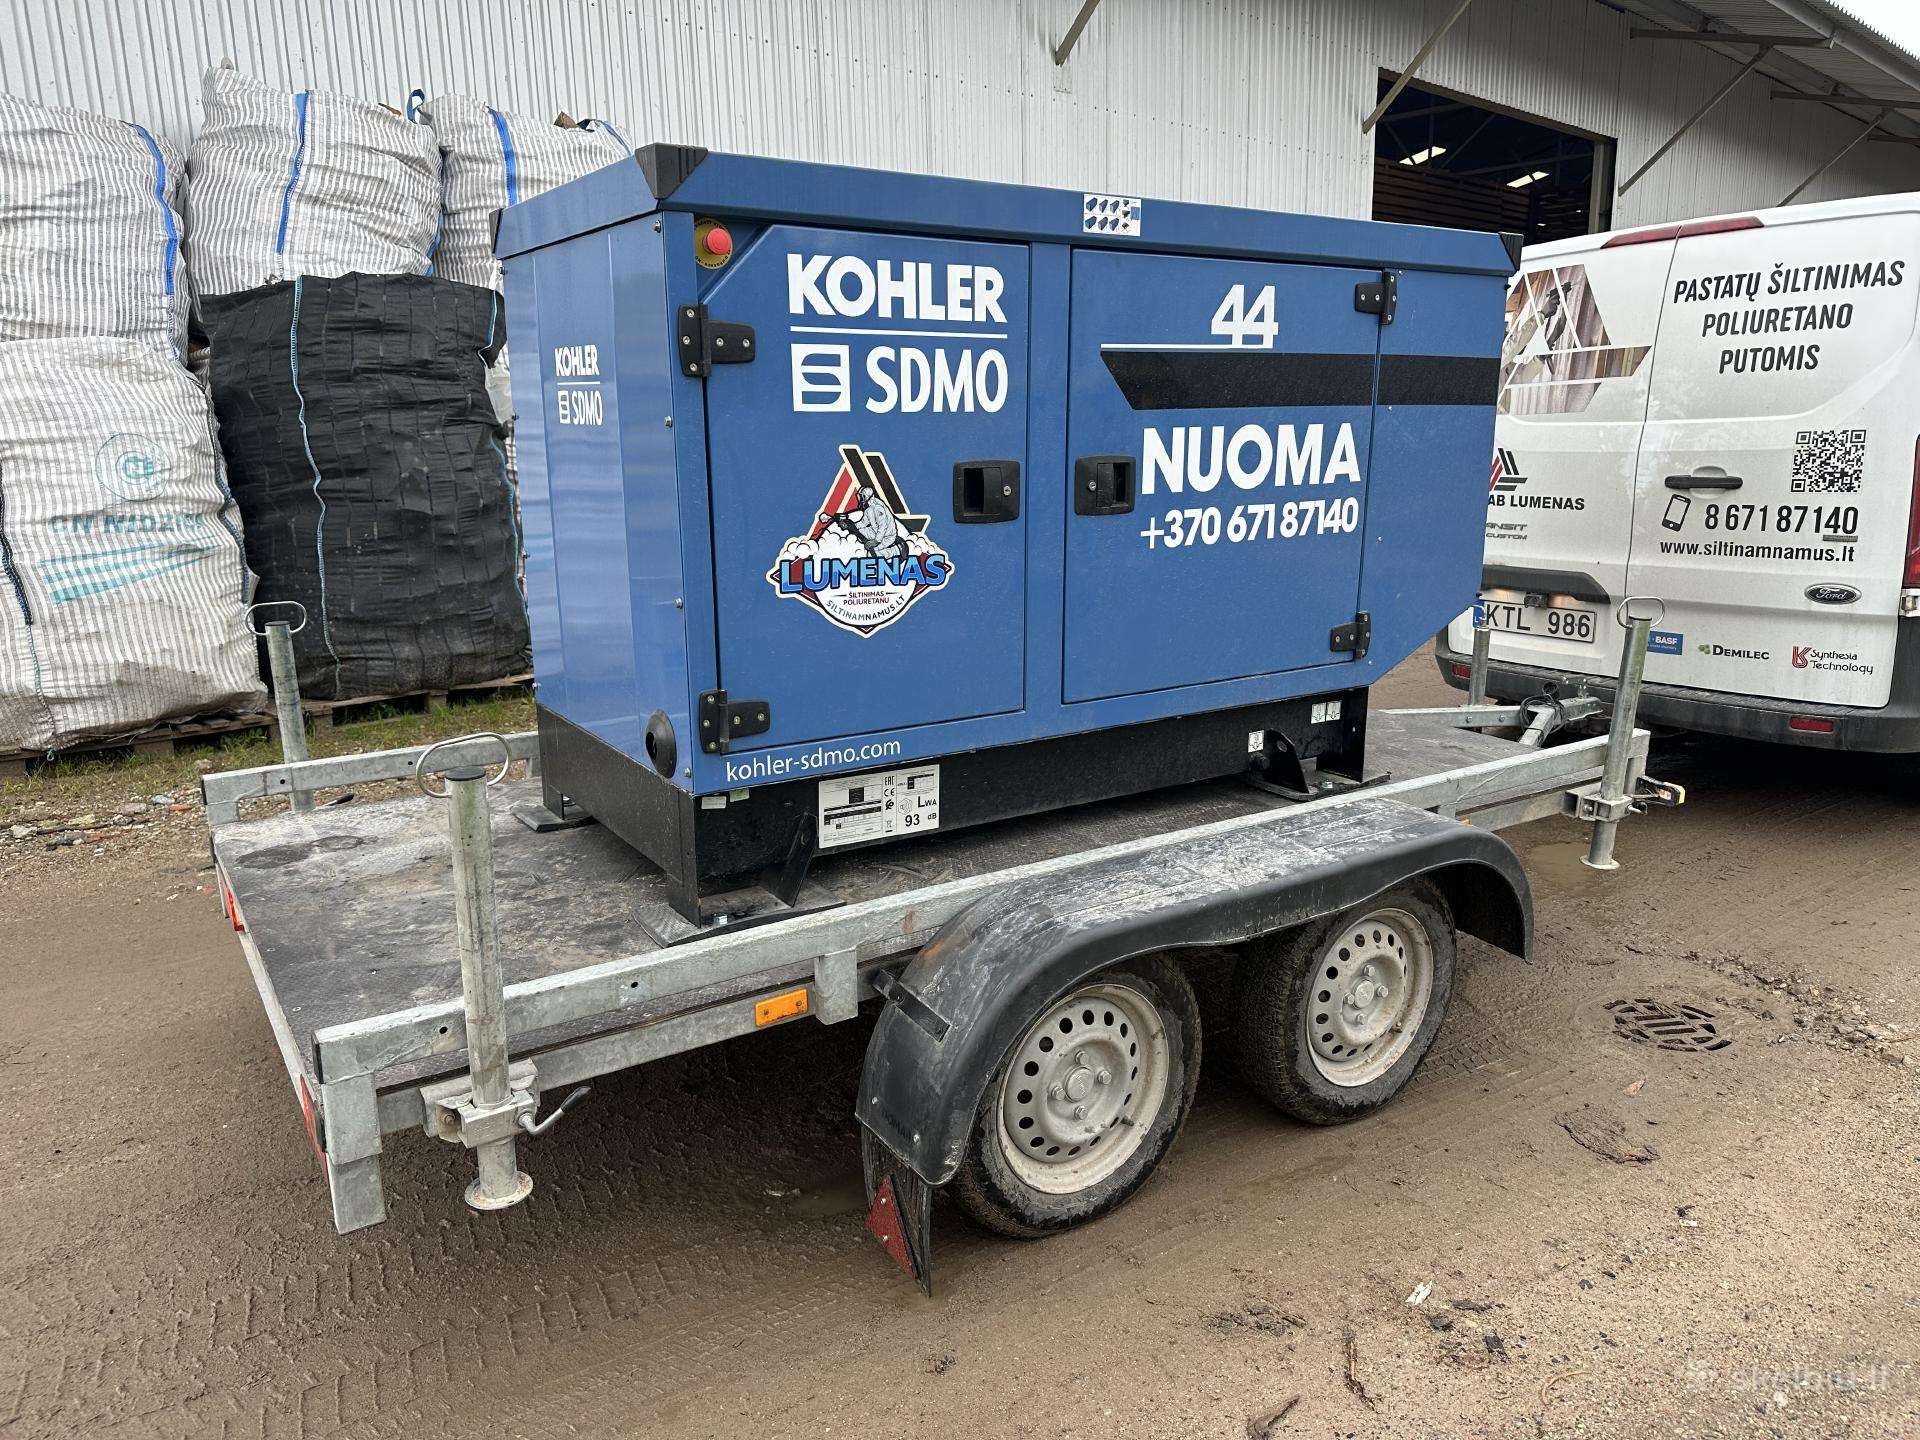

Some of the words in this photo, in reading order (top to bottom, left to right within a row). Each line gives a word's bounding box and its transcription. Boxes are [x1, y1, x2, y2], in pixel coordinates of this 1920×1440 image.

[787, 253, 1008, 323] KOHLER
[1673, 271, 1762, 304] PASTATŲ
[1767, 260, 1906, 295] ŠILTINIMAS
[1210, 284, 1279, 348] 44
[1701, 303, 1854, 338] POLIURETANO
[554, 344, 600, 377] KOHLER
[1718, 344, 1821, 374] PUTOMIS
[865, 346, 1009, 414] SDMO
[571, 390, 603, 426] SDMO
[1141, 422, 1361, 495] NUOMA
[1510, 495, 1585, 511] LUMENAS
[1704, 503, 1720, 530] 8
[1725, 504, 1769, 532] 671
[1140, 506, 1222, 550] +370
[1226, 503, 1276, 543] 671
[1279, 496, 1359, 538] 87140
[1486, 532, 1528, 541] CUSTOM
[1660, 541, 1855, 562] www.siltinamnamus.lt
[779, 553, 948, 594] LUMENAS
[1815, 586, 1848, 600] Ford
[1486, 604, 1531, 631] KTL
[1547, 611, 1591, 638] 986
[1655, 635, 1678, 645] BASF
[1712, 644, 1770, 660] DEMILEC
[1810, 649, 1858, 662] Synthesia
[1810, 660, 1874, 676] Technology
[726, 738, 901, 782] kohler-sdmo.com
[904, 813, 920, 827] 93
[927, 812, 937, 821] dB
